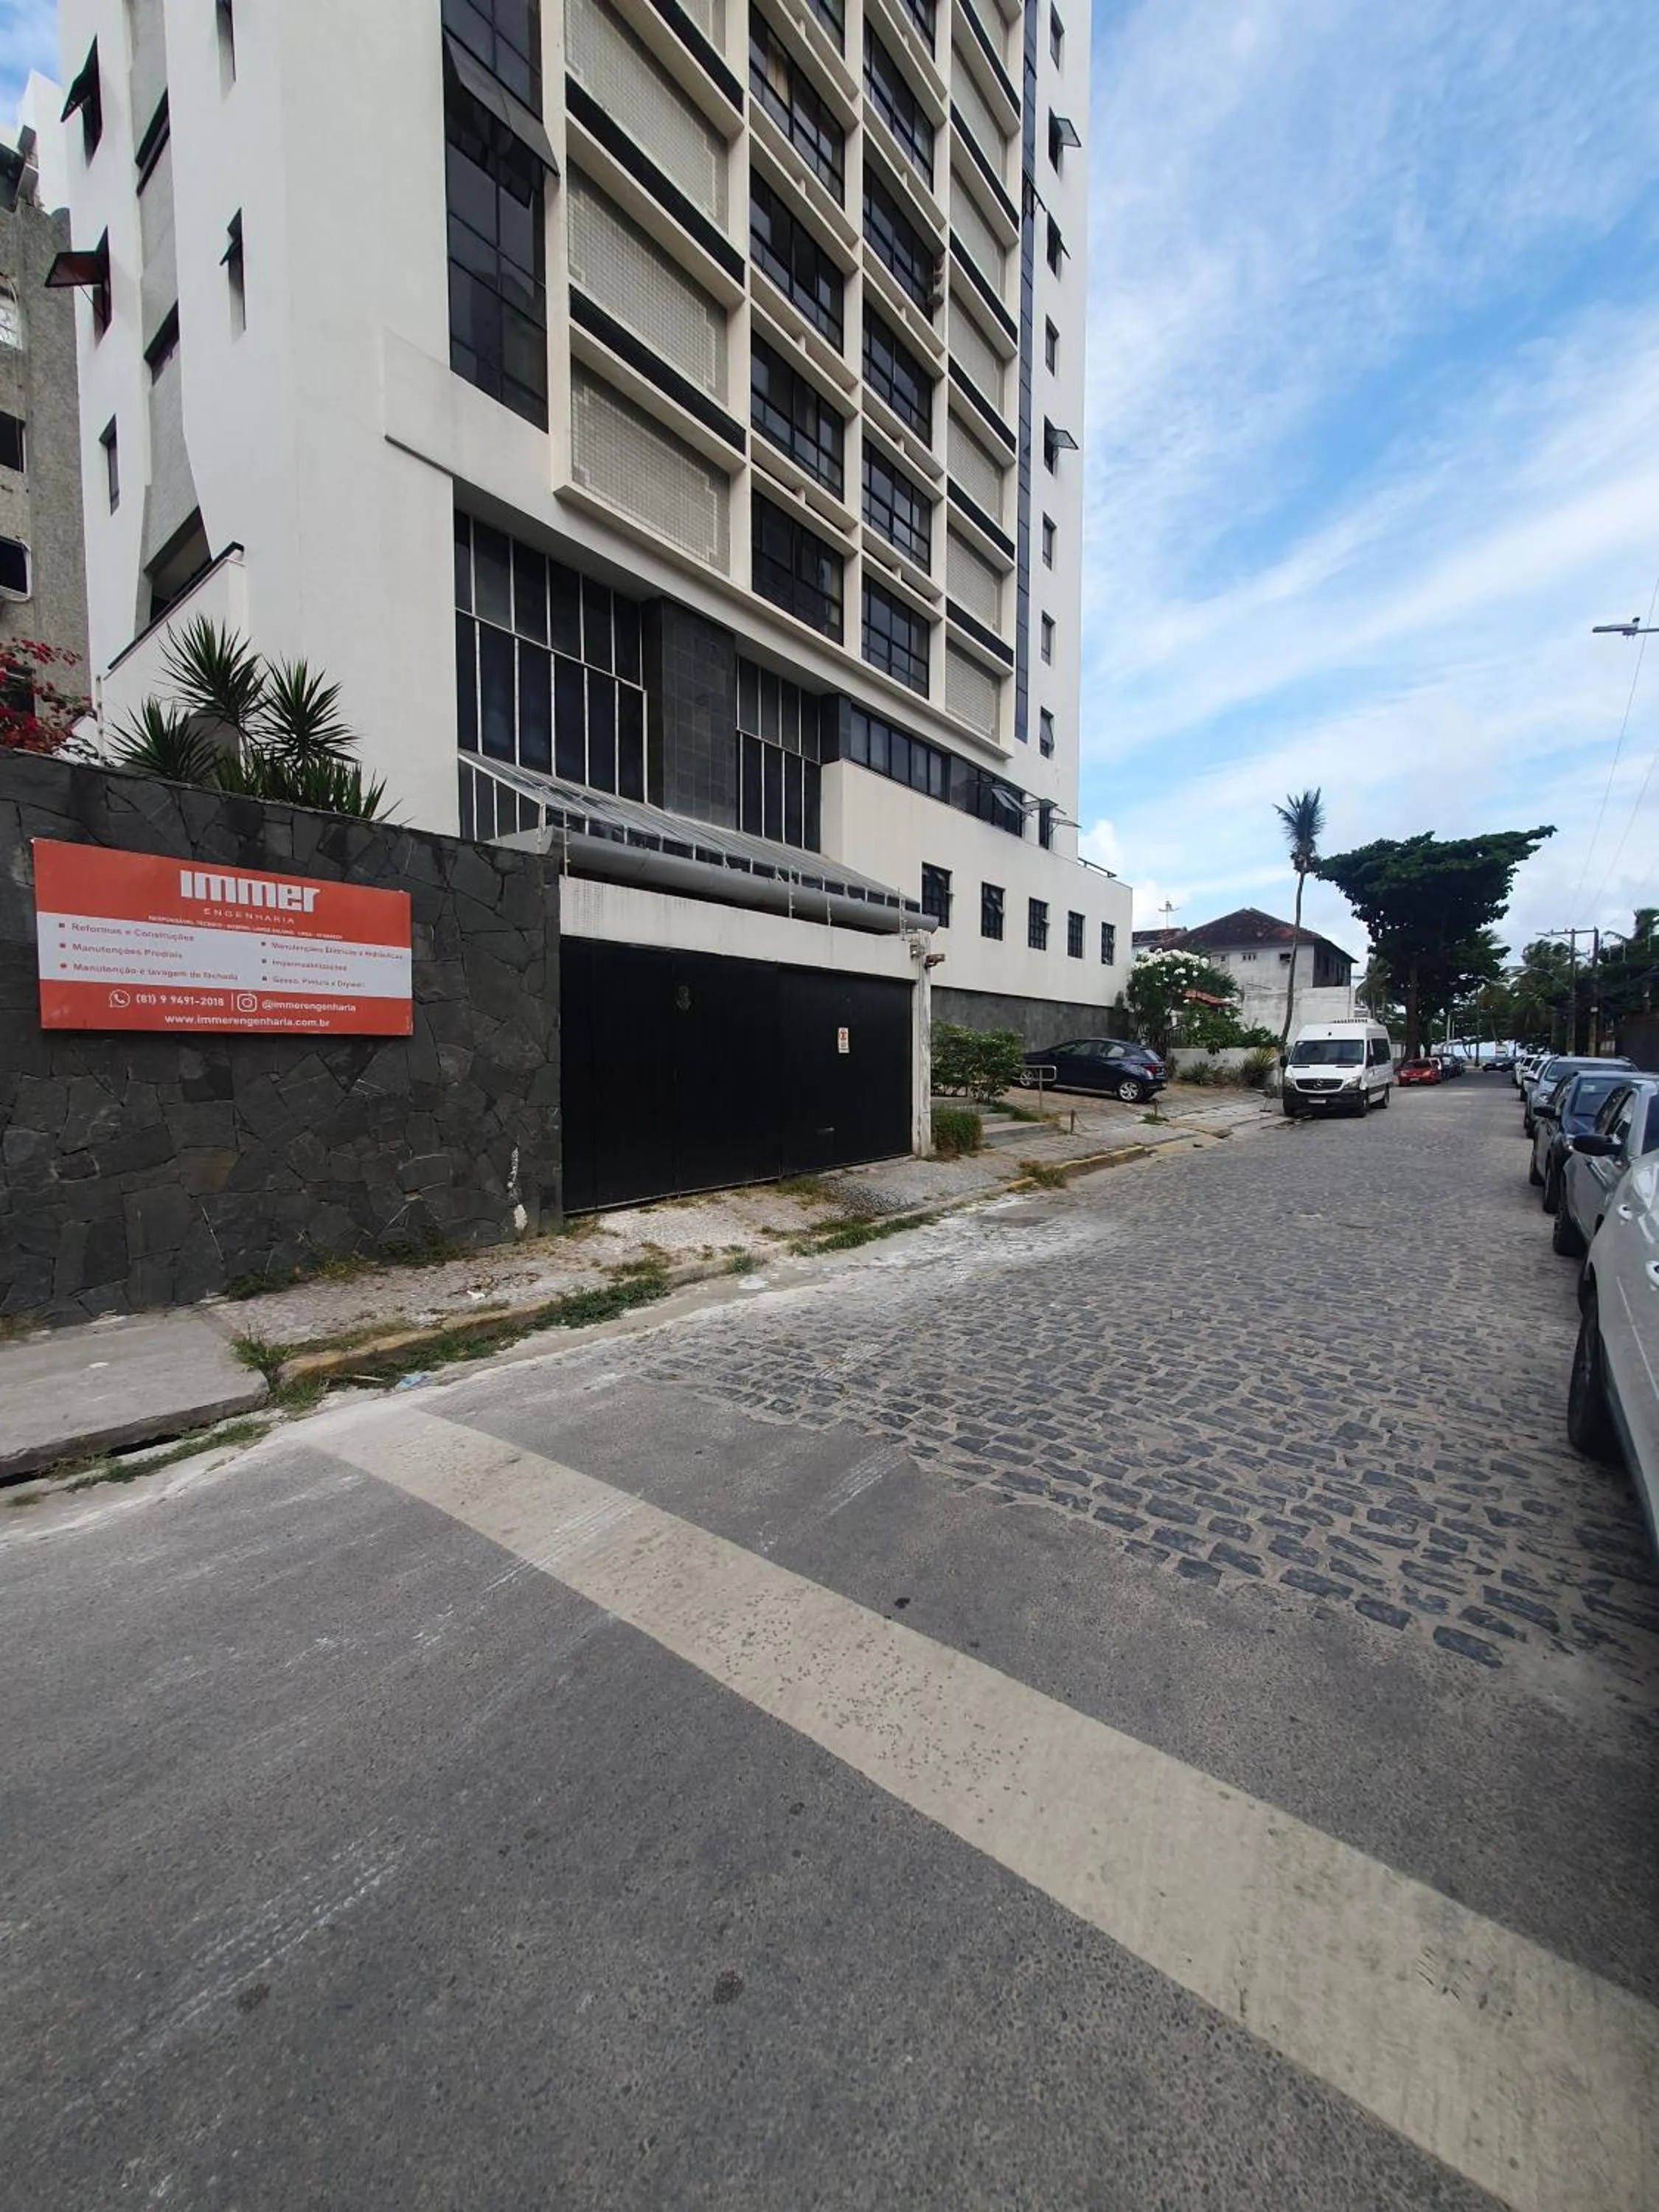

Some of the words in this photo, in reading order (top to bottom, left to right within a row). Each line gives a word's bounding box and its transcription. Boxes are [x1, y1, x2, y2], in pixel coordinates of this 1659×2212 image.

[204, 908, 294, 924] ENGENHARIA
[72, 923, 122, 935] Reformas
[133, 928, 194, 942] Construções
[72, 943, 142, 956] Manutenções
[145, 948, 183, 959] Prediais
[73, 963, 136, 975] Manutenção
[147, 968, 188, 978] lavagem
[190, 970, 201, 978] de
[203, 971, 238, 981] fachada
[136, 993, 156, 1005] (81)
[160, 995, 167, 1004] 9
[170, 995, 224, 1006] 9491-2018
[262, 999, 356, 1012] @immerengenharia
[164, 1015, 330, 1027] www.immerengenharia.com.br
